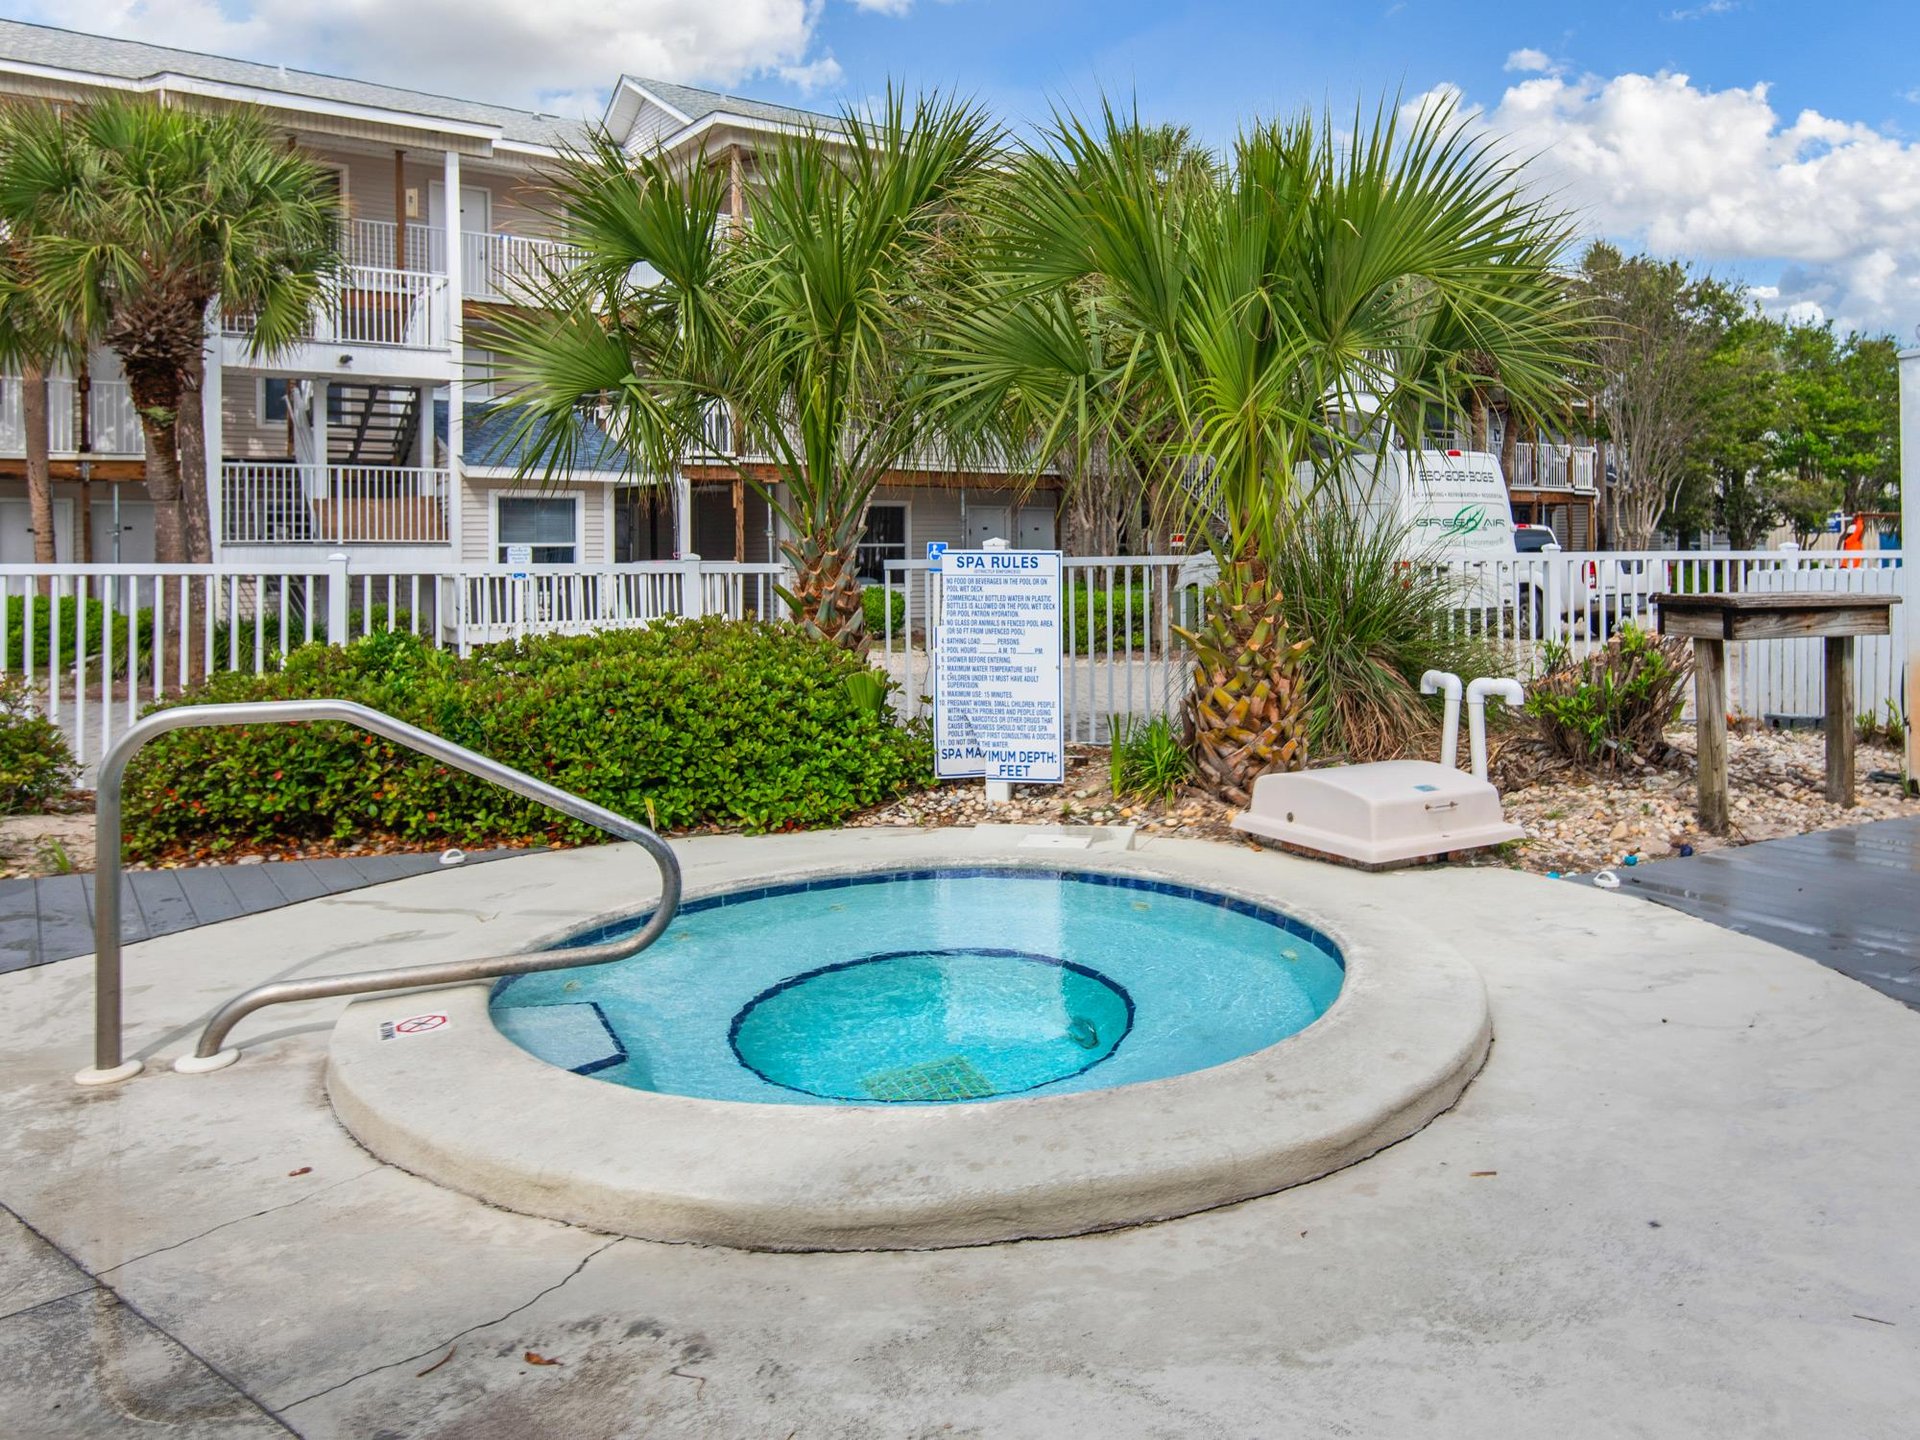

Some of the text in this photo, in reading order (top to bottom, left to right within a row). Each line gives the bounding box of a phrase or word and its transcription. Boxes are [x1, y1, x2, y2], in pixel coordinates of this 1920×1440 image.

[1484, 518, 1505, 527] AIR
[956, 556, 1038, 568] SPA RULES
[942, 748, 962, 760] SPA
[1020, 751, 1058, 763] DEPTH:
[999, 765, 1031, 776] FEET
